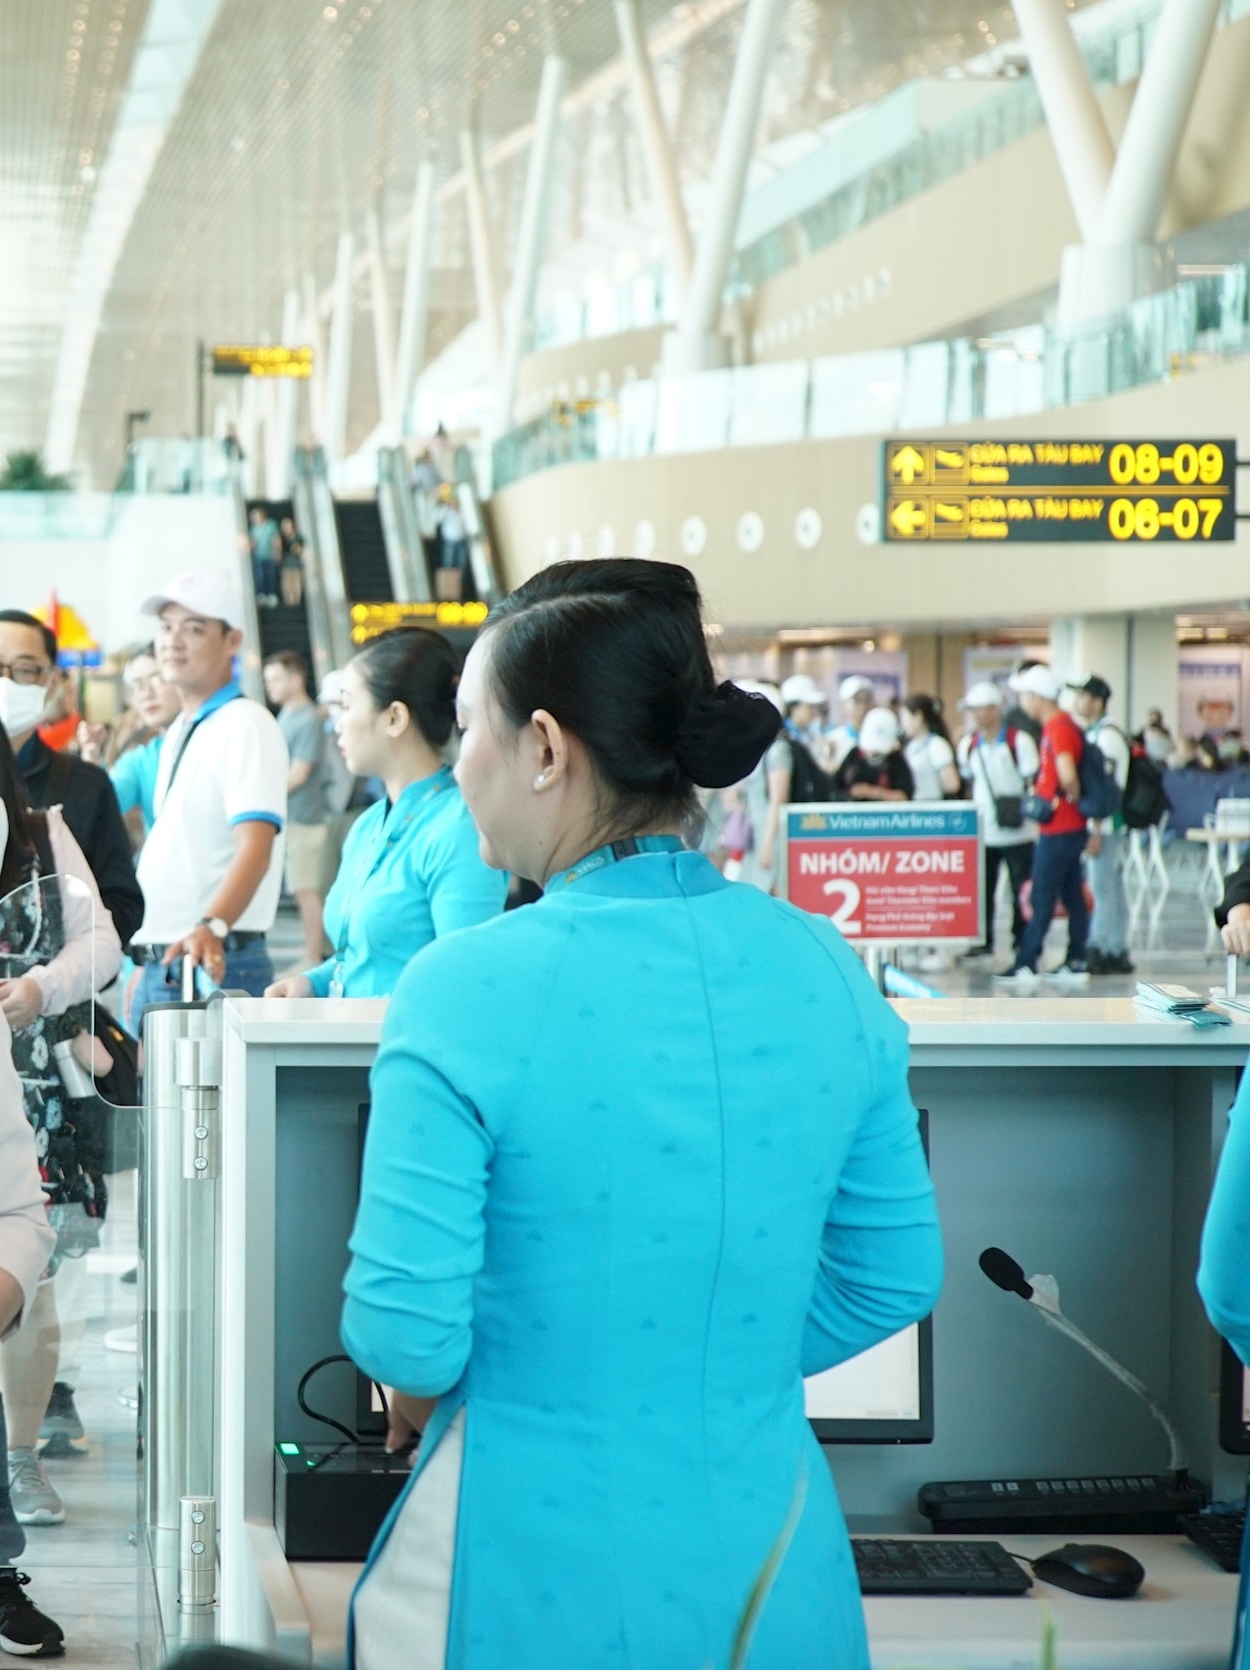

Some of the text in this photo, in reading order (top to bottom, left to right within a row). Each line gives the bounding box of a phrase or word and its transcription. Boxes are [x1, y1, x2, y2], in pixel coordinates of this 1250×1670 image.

[1109, 443, 1223, 485] 08-09
[1108, 498, 1223, 540] 06-07
[895, 850, 965, 874] ZONE
[823, 878, 862, 935] 2
